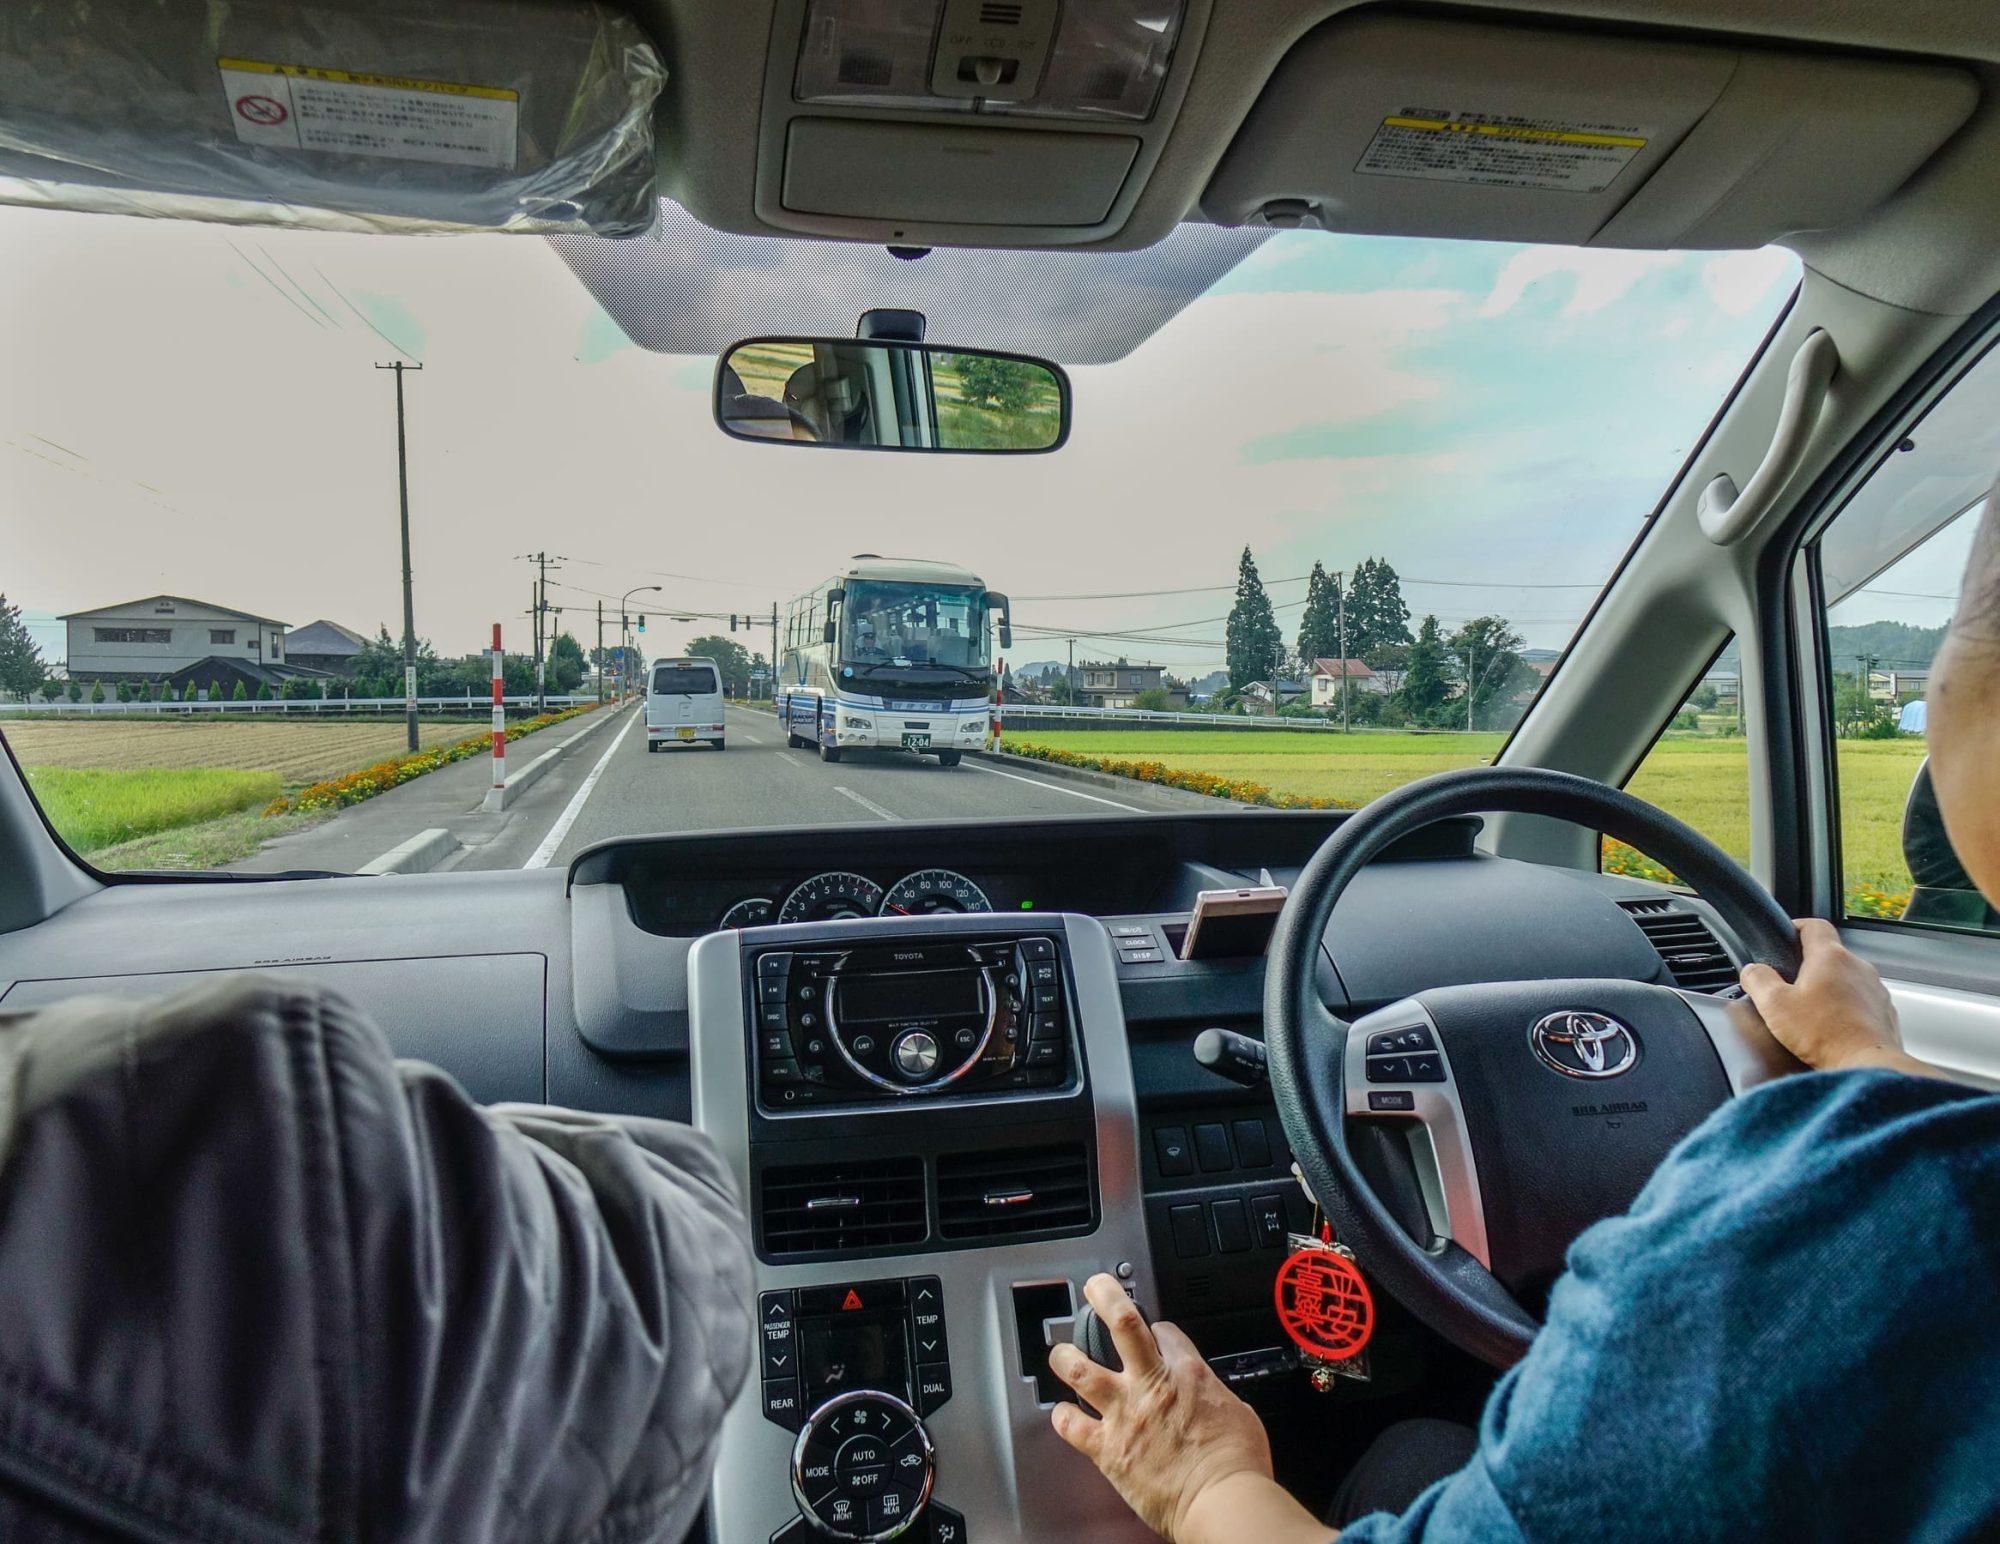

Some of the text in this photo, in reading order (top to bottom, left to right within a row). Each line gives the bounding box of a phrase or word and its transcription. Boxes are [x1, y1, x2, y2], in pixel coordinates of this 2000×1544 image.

[838, 885, 845, 893] 6
[920, 880, 930, 890] 80
[938, 880, 952, 889] 100
[824, 886, 830, 894] 5
[853, 888, 859, 896] 7
[904, 890, 915, 899] 60
[956, 889, 969, 898] 120
[810, 892, 816, 900] 4
[866, 894, 872, 902] 8
[967, 902, 981, 911] 140
[894, 952, 924, 960] TOYOTA
[1132, 952, 1151, 960] DISP
[916, 1314, 939, 1325] TEMP
[764, 1319, 791, 1331] PASSENGER
[767, 1329, 790, 1340] TEMP
[923, 1383, 945, 1394] DUAL
[770, 1398, 794, 1410] REAR
[852, 1450, 876, 1462] AUTO
[805, 1466, 830, 1478] MODE
[861, 1473, 879, 1484] OFF
[883, 1504, 901, 1515] REAR
[833, 1511, 852, 1521] FRONT
